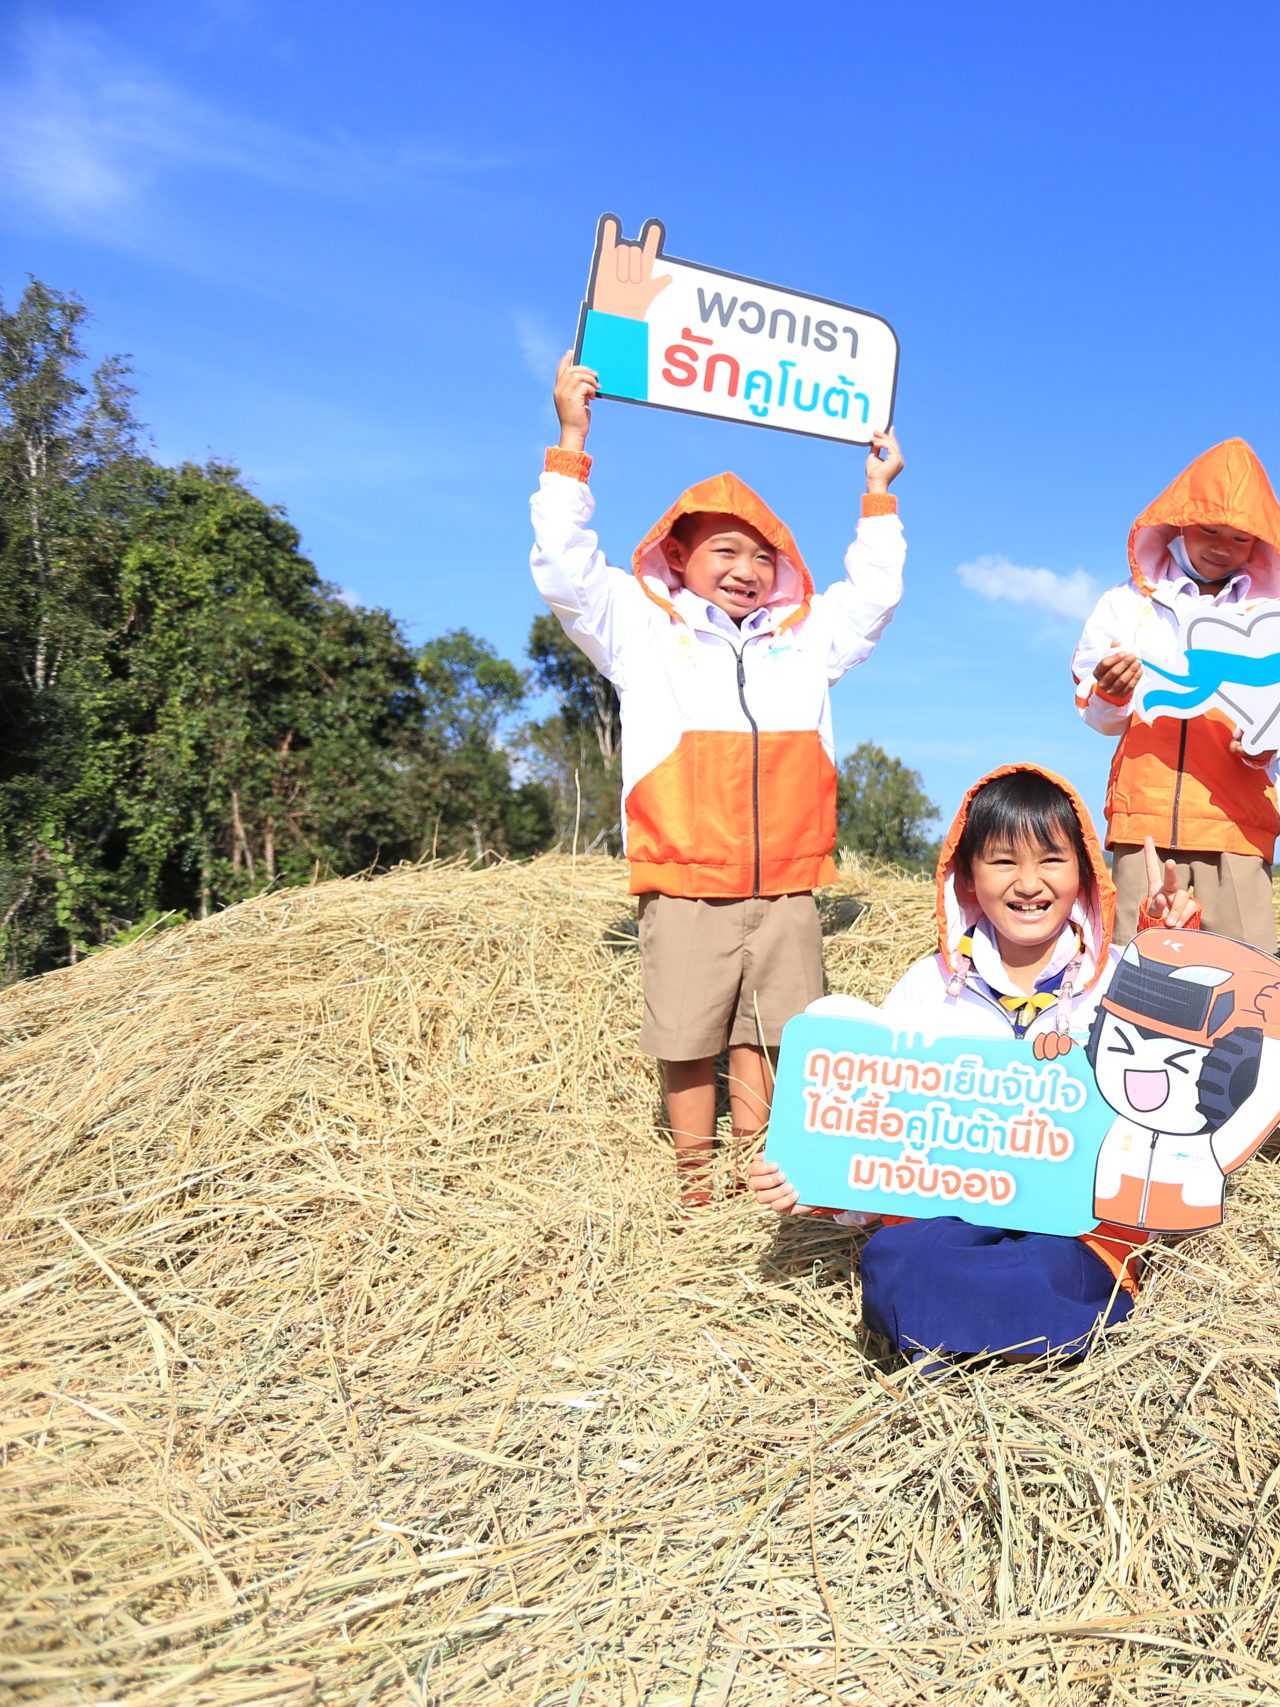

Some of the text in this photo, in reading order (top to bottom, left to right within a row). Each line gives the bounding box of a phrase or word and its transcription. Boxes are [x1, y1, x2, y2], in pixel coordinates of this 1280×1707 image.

[697, 287, 859, 359] พวกเรา
[808, 1053, 1082, 1108] ฤดูหนาวเย็นจับใจ
[808, 1091, 1070, 1158] ได้เสื้อคูโบต้านี่ไง
[852, 1155, 1012, 1201] มาจับจอง
